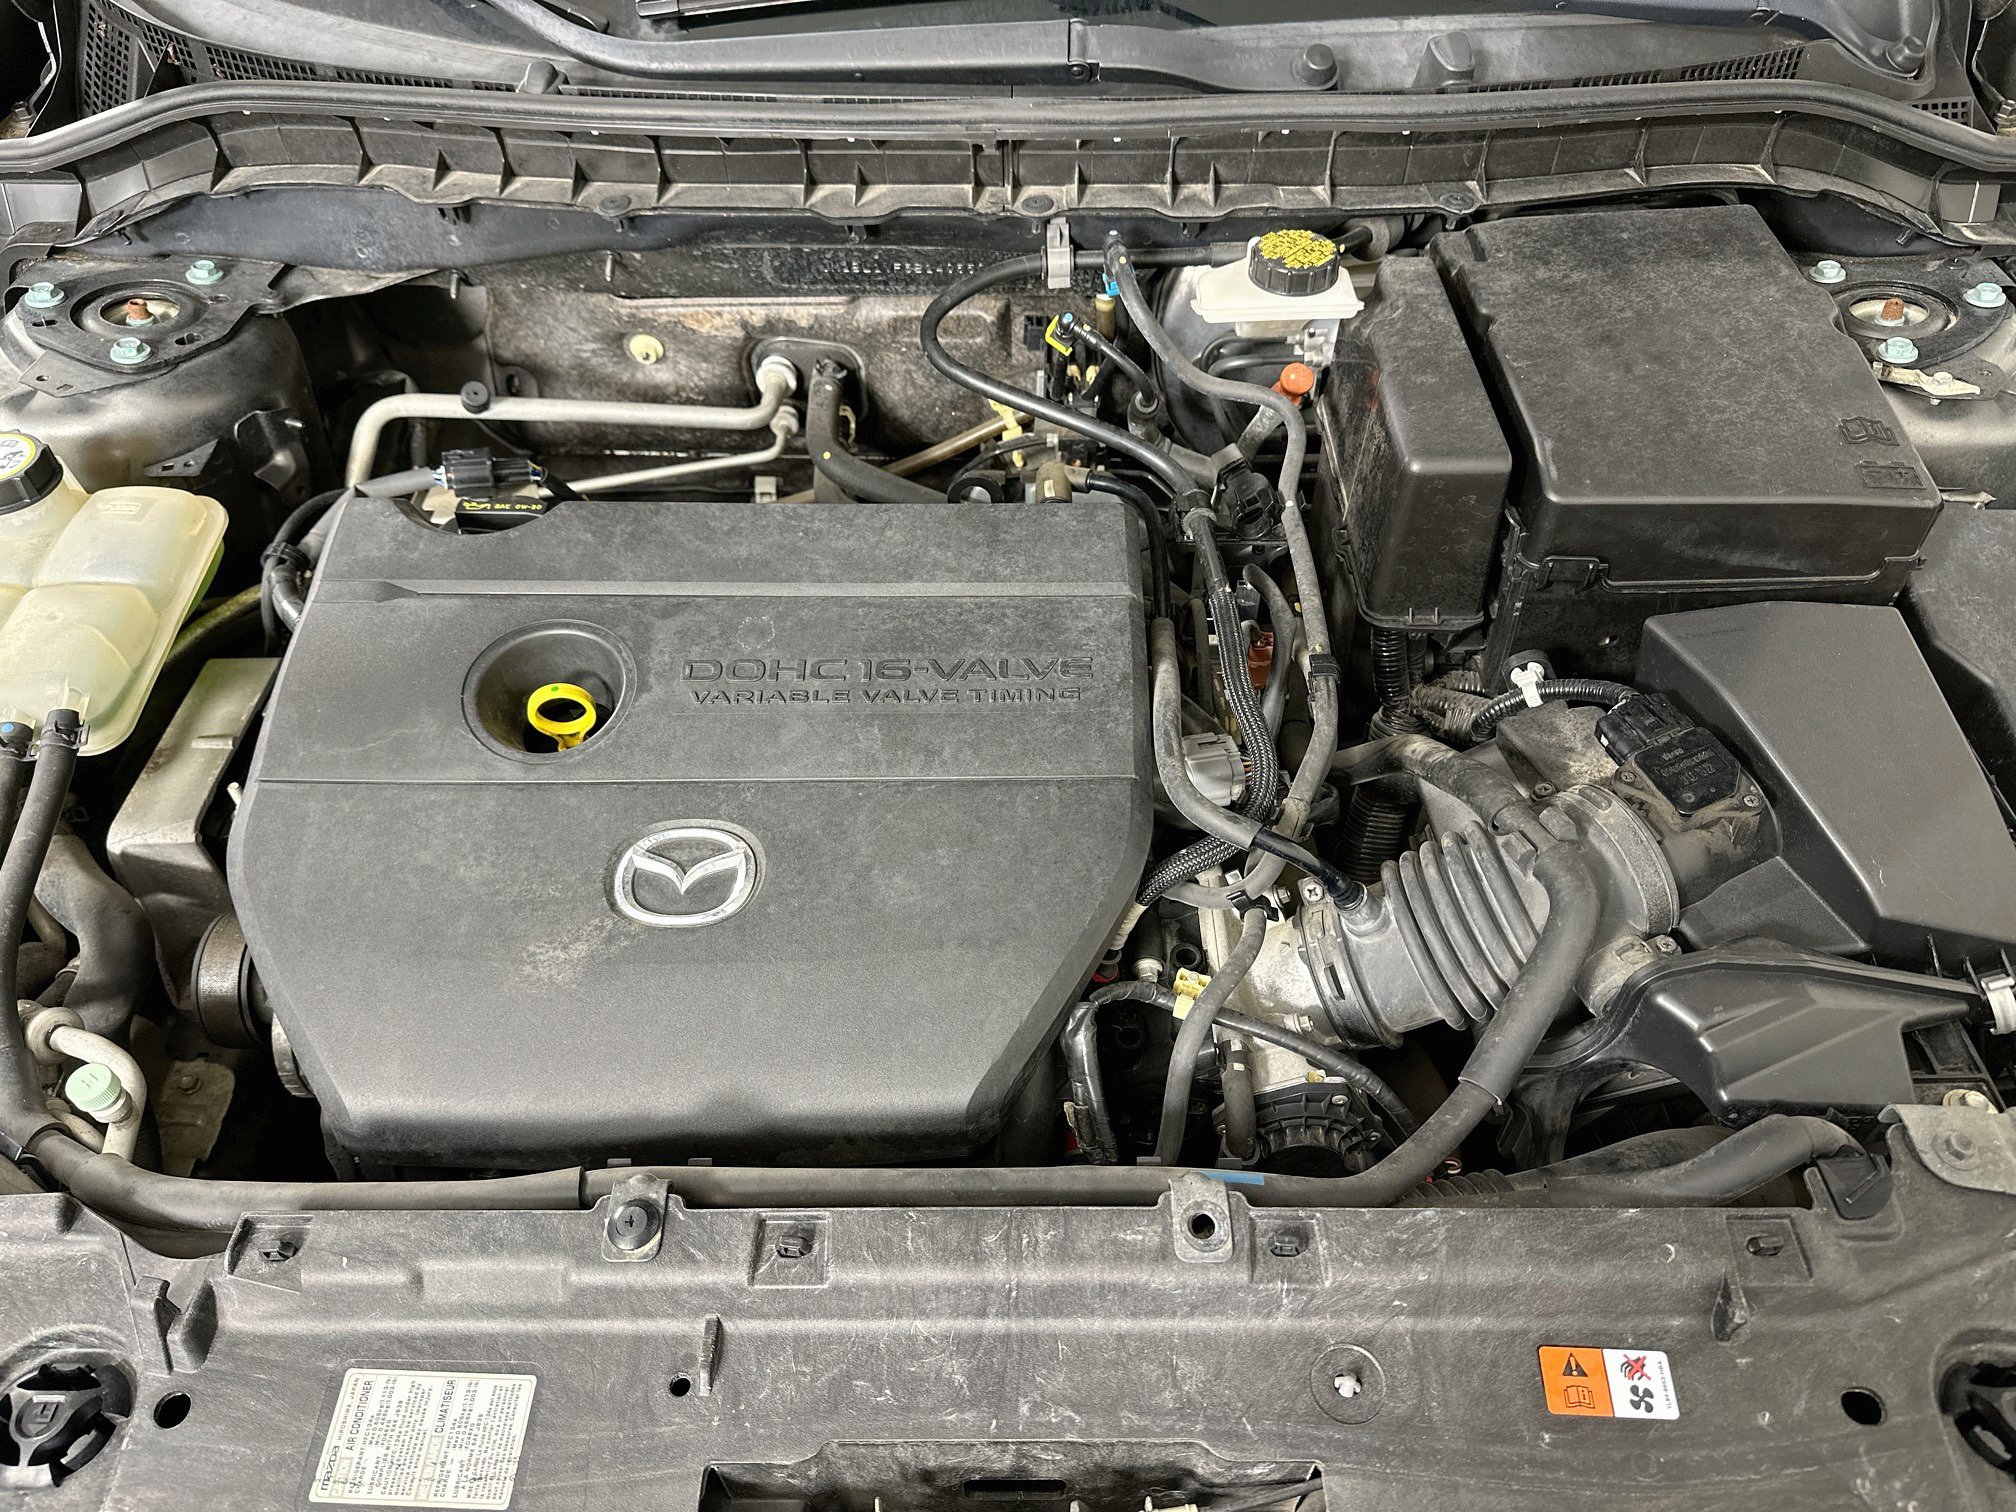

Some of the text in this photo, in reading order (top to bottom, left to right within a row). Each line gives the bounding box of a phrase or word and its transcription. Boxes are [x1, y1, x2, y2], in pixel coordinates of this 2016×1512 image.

[680, 655, 1094, 683] DOHC 16-VALVE
[689, 687, 1082, 704] VARIABLE VALVE TIMING
[337, 1378, 360, 1441] HIROSHIMA, JAPAN
[345, 1381, 374, 1451] AIR CONDITIONER
[435, 1380, 457, 1433] CLIMATISEUR
